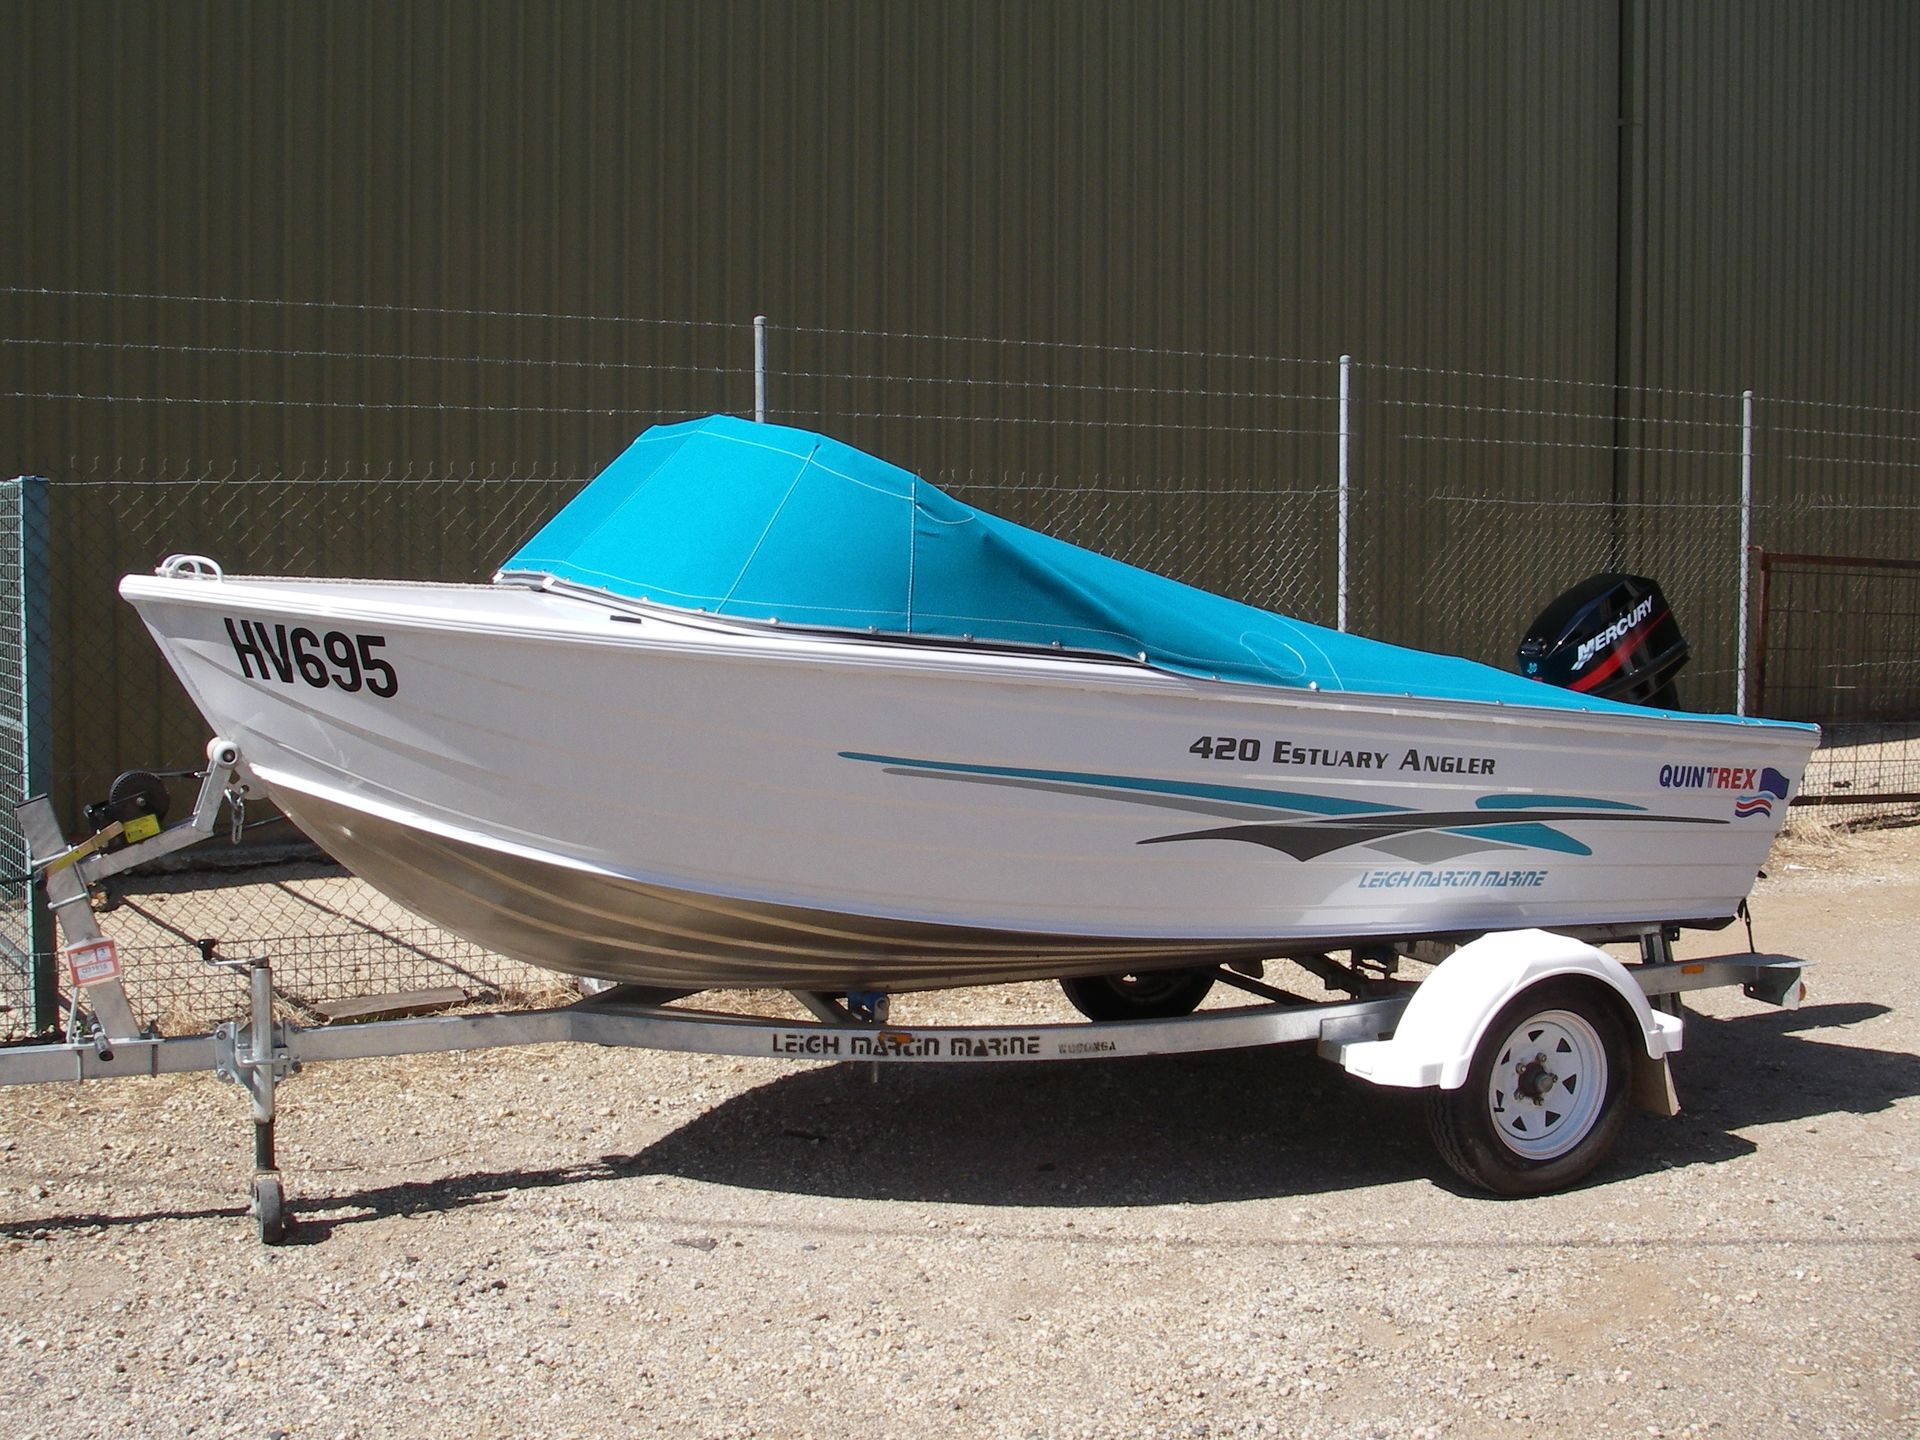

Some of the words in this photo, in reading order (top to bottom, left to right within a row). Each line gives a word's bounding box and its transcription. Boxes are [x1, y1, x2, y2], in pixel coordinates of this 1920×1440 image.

[224, 617, 398, 697] HV695
[1571, 595, 1652, 671] MERCURY
[1189, 736, 1260, 762] 420
[1660, 764, 1757, 790] QUINTREX
